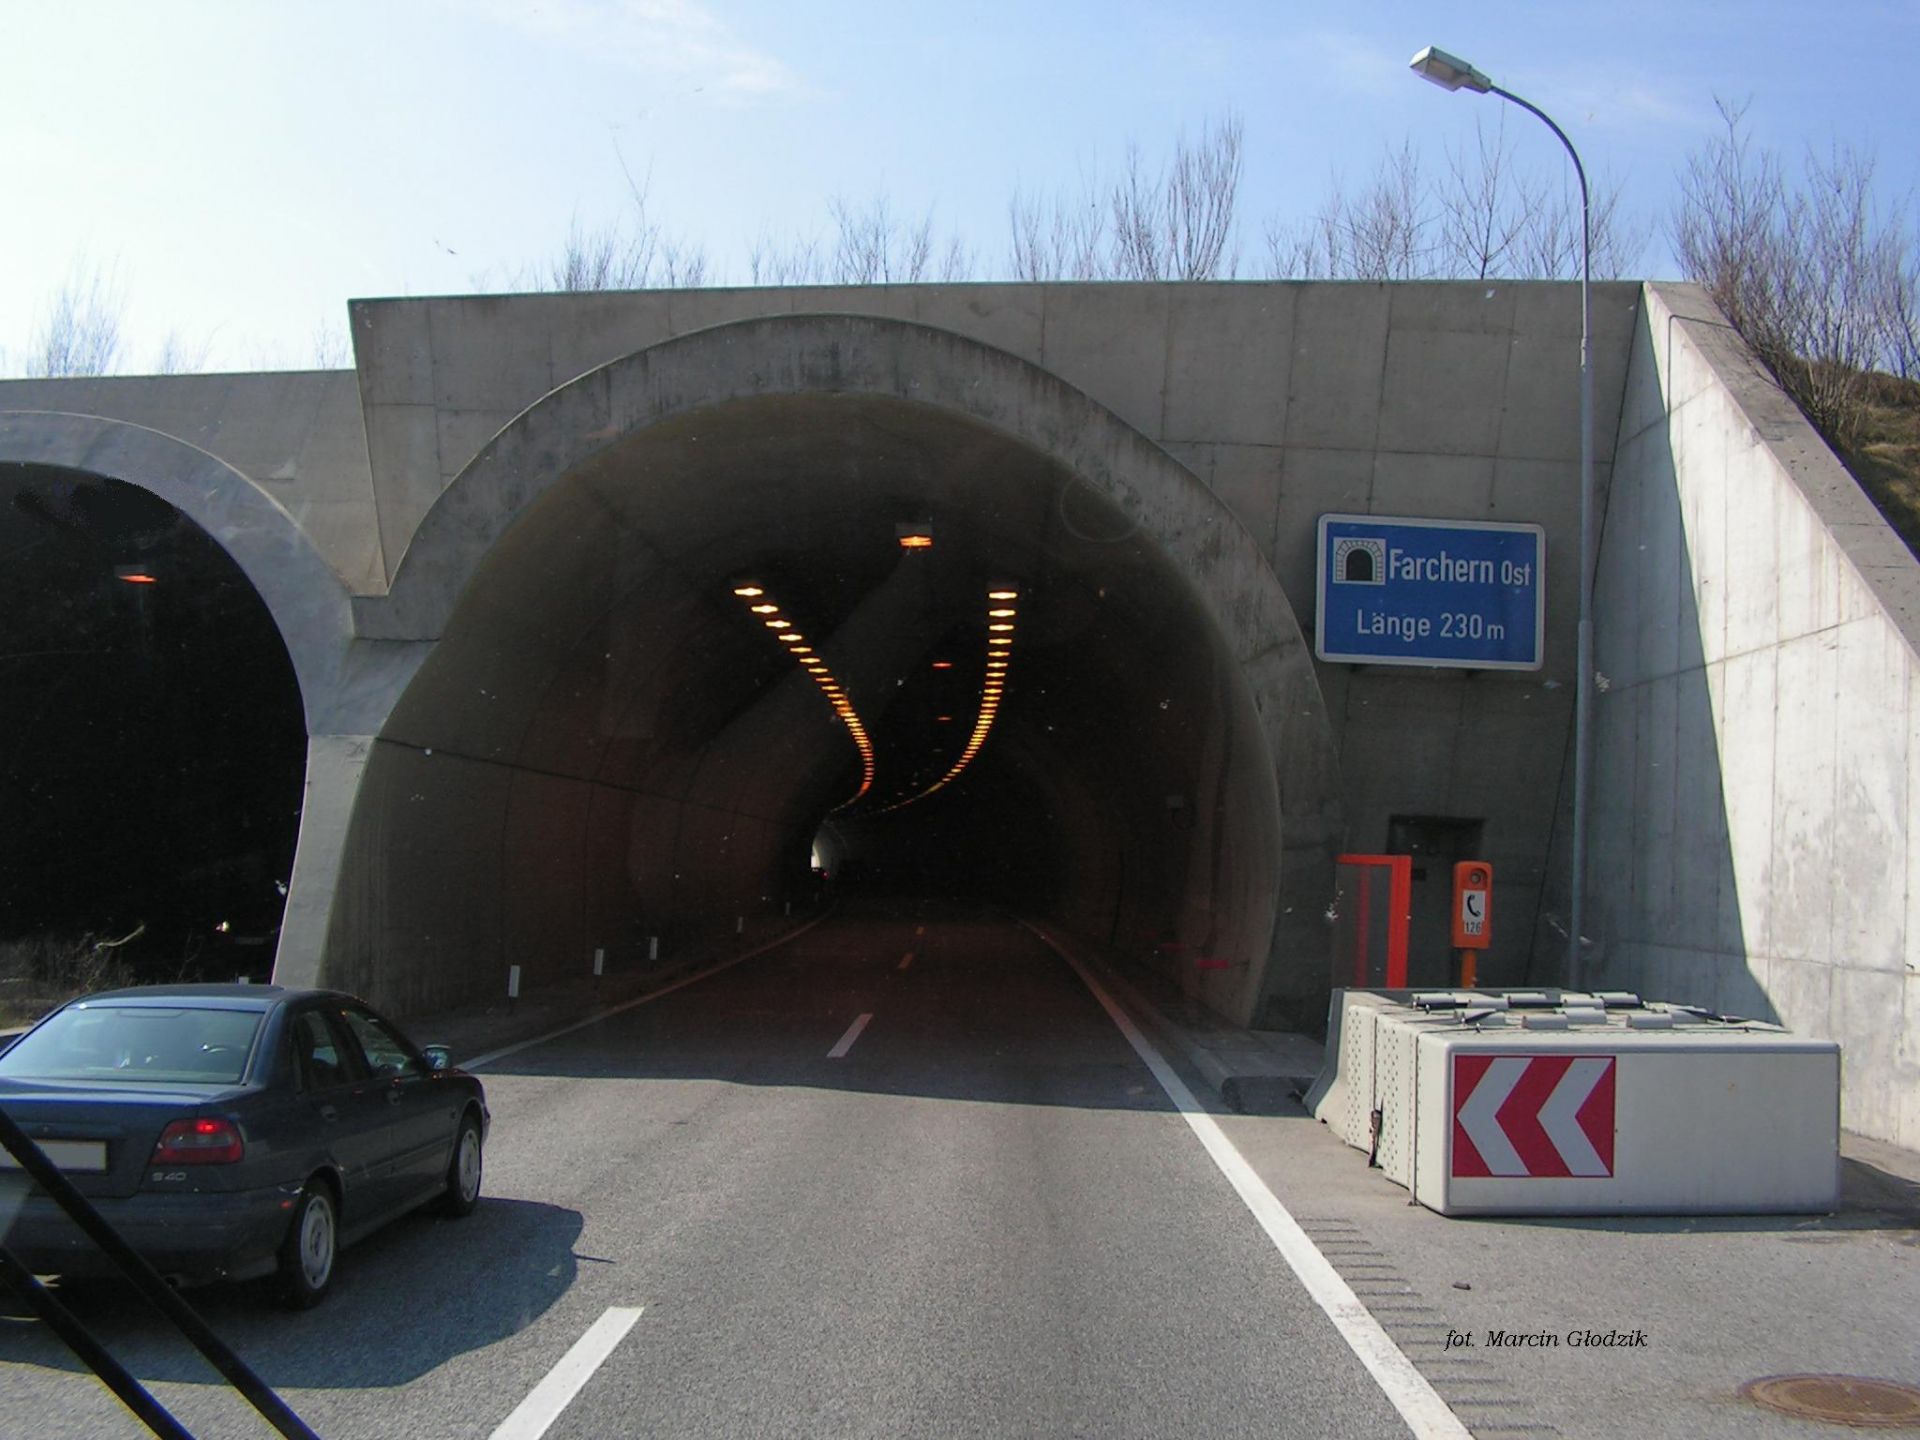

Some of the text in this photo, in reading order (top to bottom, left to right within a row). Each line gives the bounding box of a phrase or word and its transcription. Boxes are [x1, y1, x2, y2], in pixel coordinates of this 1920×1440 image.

[1389, 548, 1531, 586] Farchern Ost
[1357, 609, 1505, 642] Länge 230 m
[1465, 921, 1482, 933] 126
